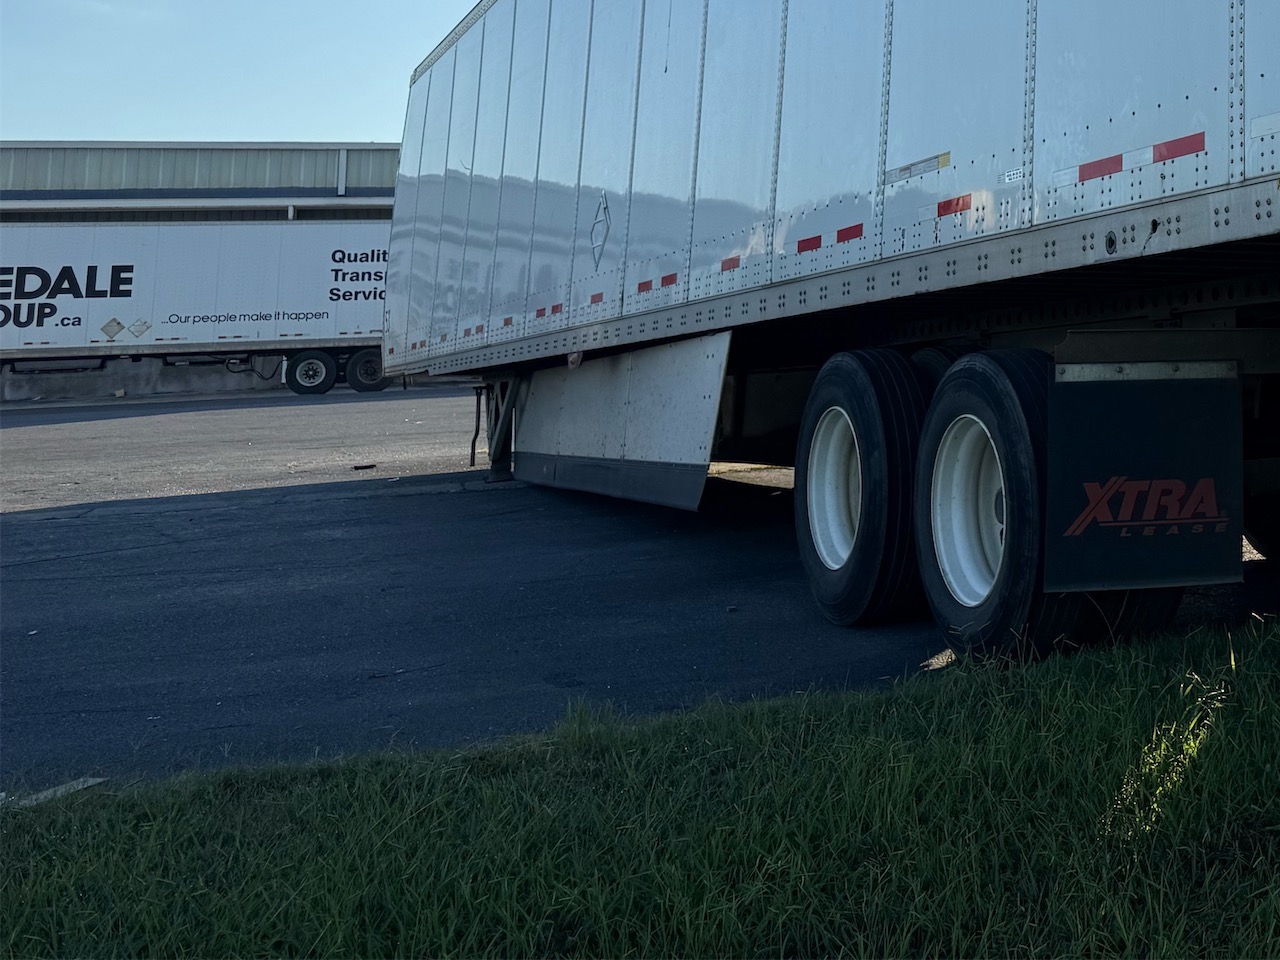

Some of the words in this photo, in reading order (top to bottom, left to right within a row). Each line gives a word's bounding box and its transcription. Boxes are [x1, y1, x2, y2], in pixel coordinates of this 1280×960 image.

[0, 265, 134, 300] EDALE
[330, 268, 387, 285] Trans
[193, 312, 237, 324] people
[238, 311, 273, 323] make
[274, 310, 281, 321] it
[282, 310, 329, 322] happen
[1062, 476, 1219, 536] XTRA
[1120, 522, 1228, 537] LEASE
